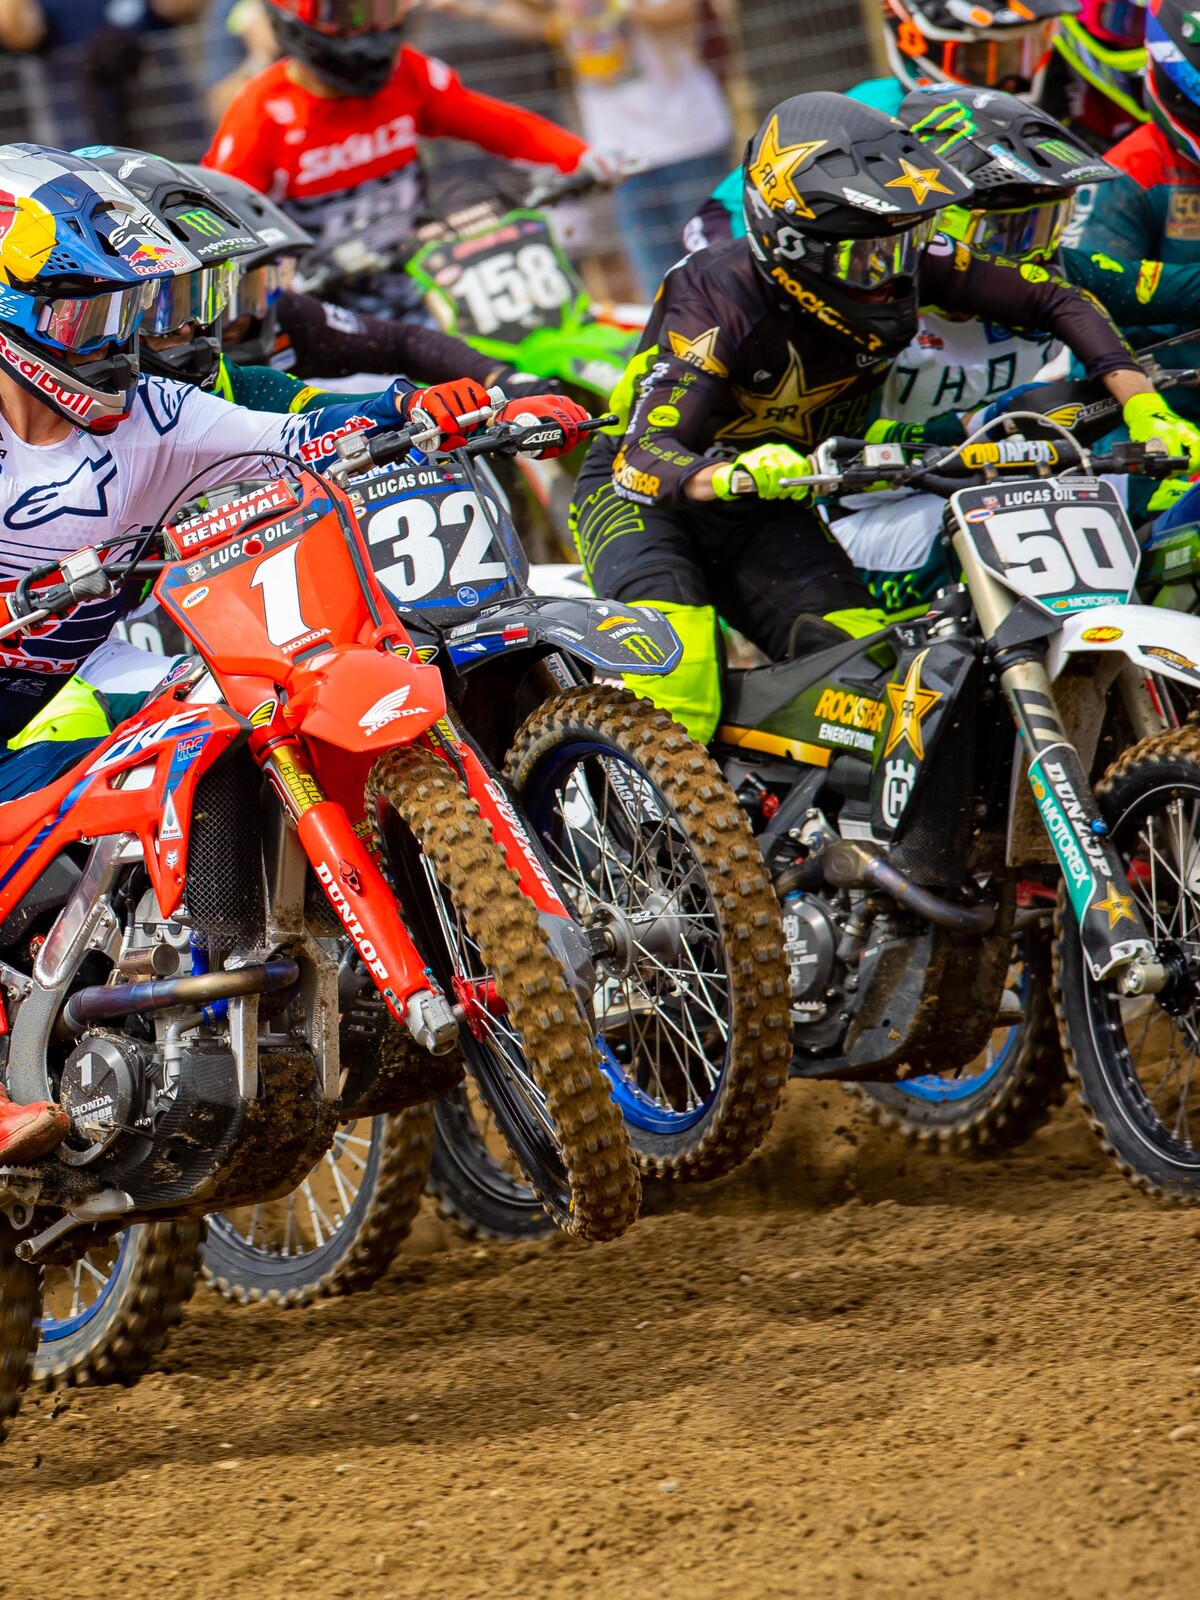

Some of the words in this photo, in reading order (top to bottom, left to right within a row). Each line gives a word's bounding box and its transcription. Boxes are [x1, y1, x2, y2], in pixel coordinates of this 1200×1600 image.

[133, 261, 168, 277] Red
[166, 256, 191, 271] Bull
[451, 243, 572, 335] 158
[36, 369, 99, 419] Bull
[300, 414, 378, 463] HODA
[521, 429, 562, 445] ARC
[175, 482, 279, 535] RENTHAL
[367, 473, 417, 501] LUCAS
[418, 470, 445, 486] OIL
[1004, 488, 1052, 507] LUCAS
[1053, 488, 1079, 502] OIL
[181, 492, 288, 548] RENTHAL
[264, 521, 293, 543] OIL
[367, 490, 509, 604] 32
[983, 506, 1135, 596] 50
[249, 539, 316, 648] 1
[281, 627, 333, 655] HONDA
[363, 705, 430, 737] HONDA
[813, 688, 887, 733] ROCKSTAR
[818, 722, 857, 747] ENERGY
[853, 729, 876, 752] DRINK
[1044, 760, 1113, 878] DUNLOP
[1041, 800, 1091, 889] MOTOREX
[315, 861, 390, 981] DUNLOP
[75, 1052, 93, 1088] 1
[70, 1094, 115, 1118] HONDA
